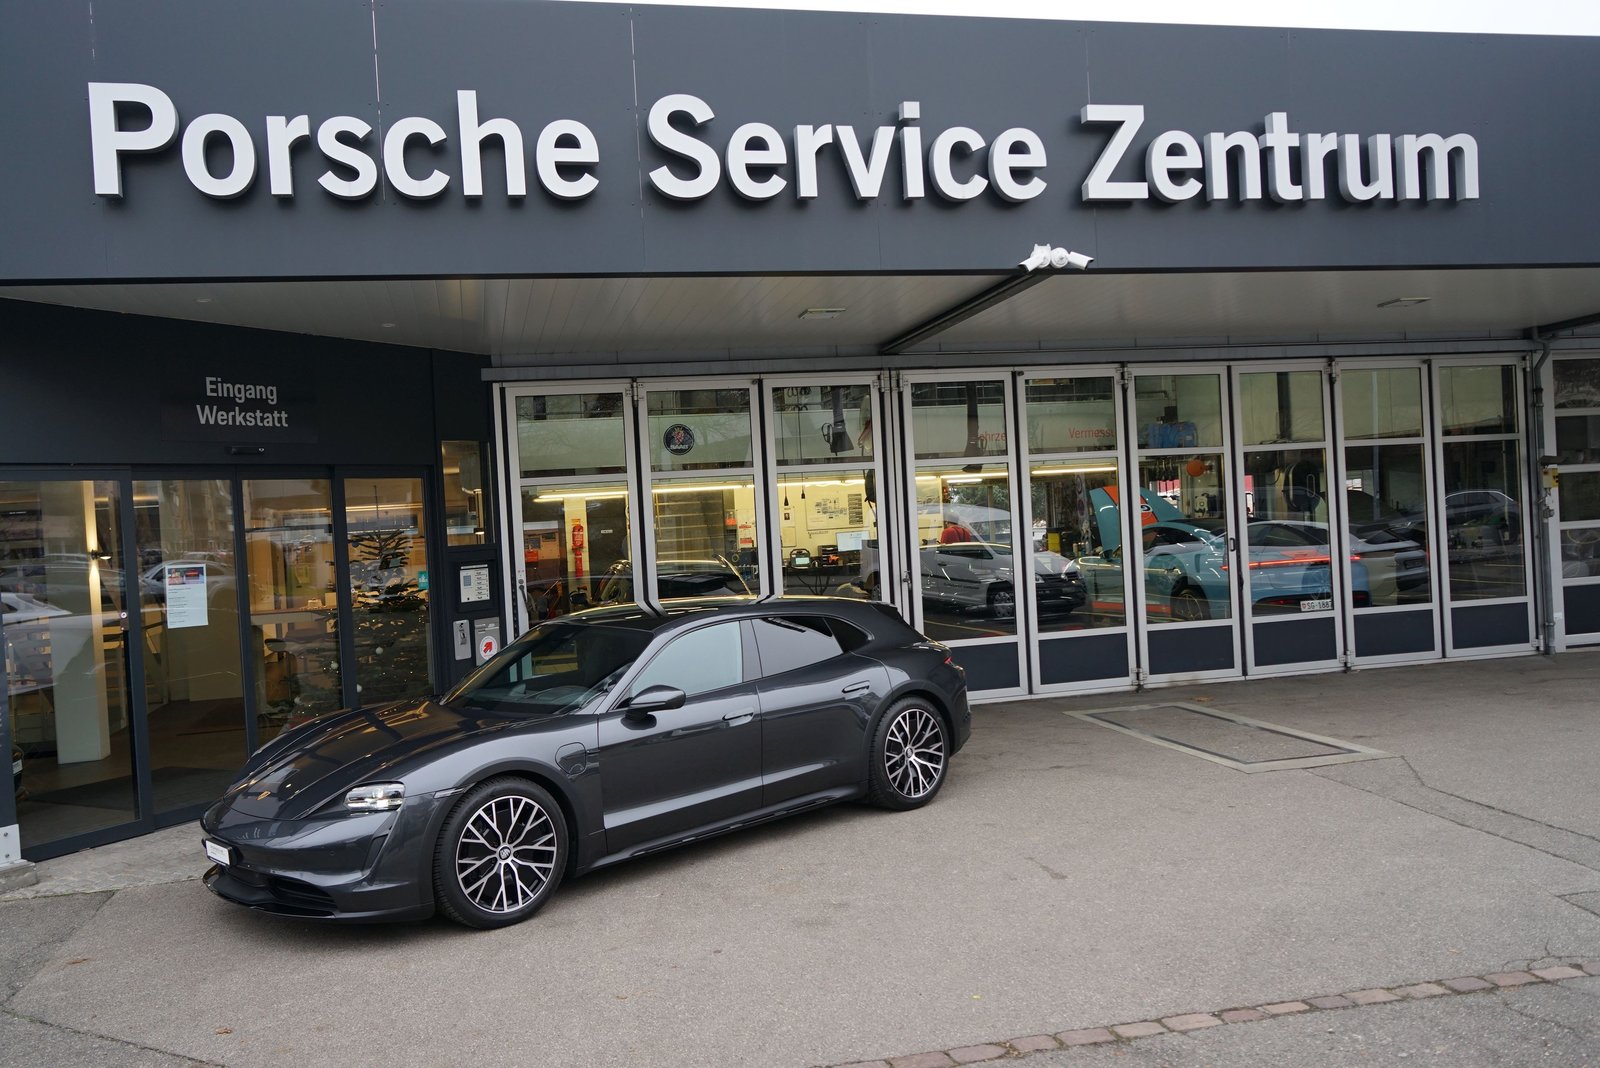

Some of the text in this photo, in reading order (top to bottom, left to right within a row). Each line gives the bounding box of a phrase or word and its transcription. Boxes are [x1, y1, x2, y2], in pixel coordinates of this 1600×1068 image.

[88, 81, 1480, 202] Porsche Service Zentrum
[205, 376, 278, 405] Eingang
[196, 404, 288, 428] Werkstatt
